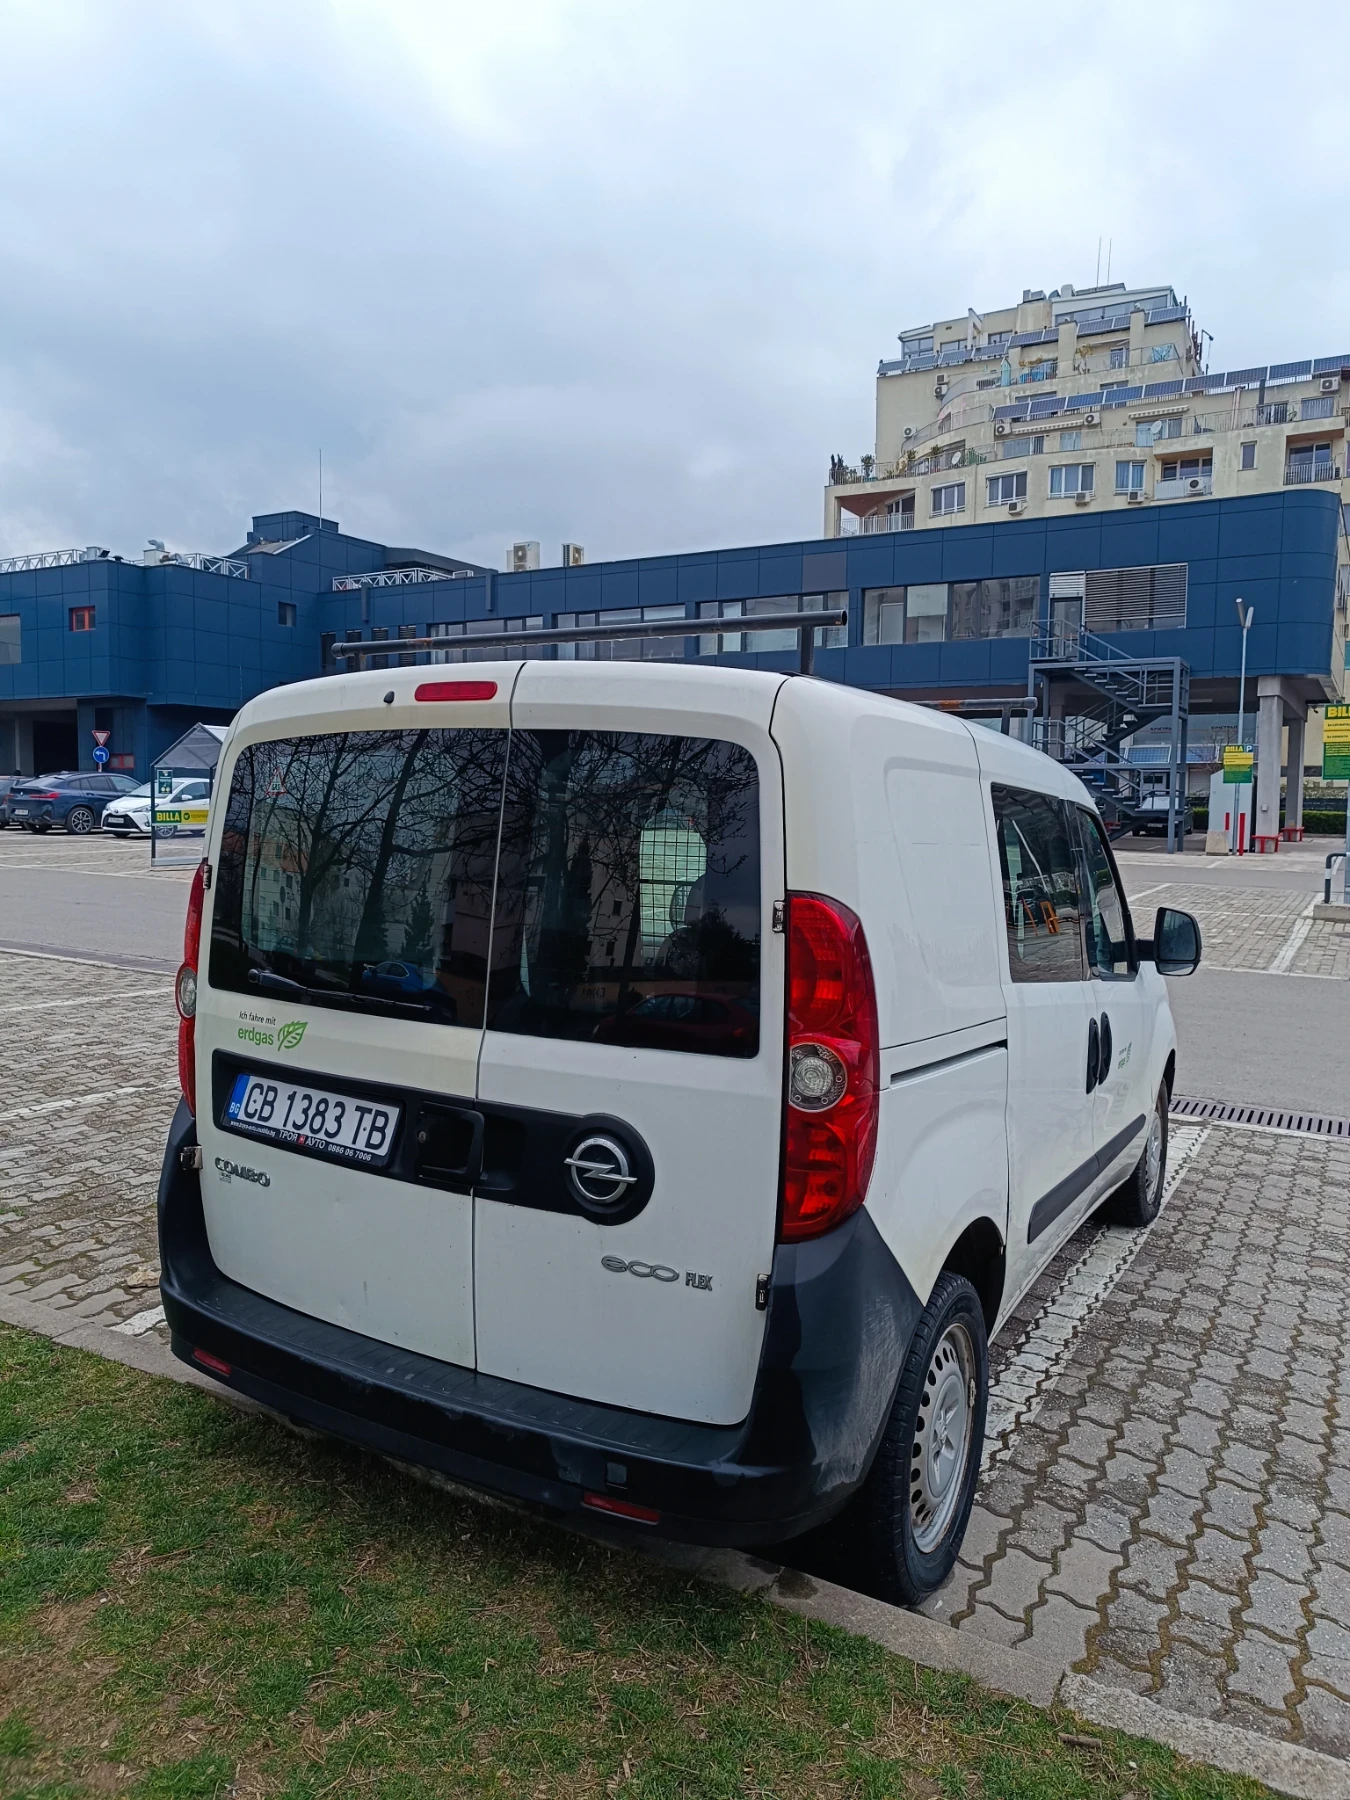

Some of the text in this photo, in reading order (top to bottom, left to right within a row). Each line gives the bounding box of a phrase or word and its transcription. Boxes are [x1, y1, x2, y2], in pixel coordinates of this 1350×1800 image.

[1327, 706, 1350, 718] BIL
[156, 812, 180, 821] BILLA
[239, 1011, 276, 1025] Ich fahre mit
[238, 1027, 274, 1046] erdgas
[229, 1102, 240, 1114] BG
[244, 1083, 390, 1150] CB 1383 TB
[279, 1129, 298, 1142] ТРОЯ
[305, 1137, 326, 1149] АУТО
[214, 1156, 270, 1187] COMBO
[685, 1270, 713, 1291] FLEX
